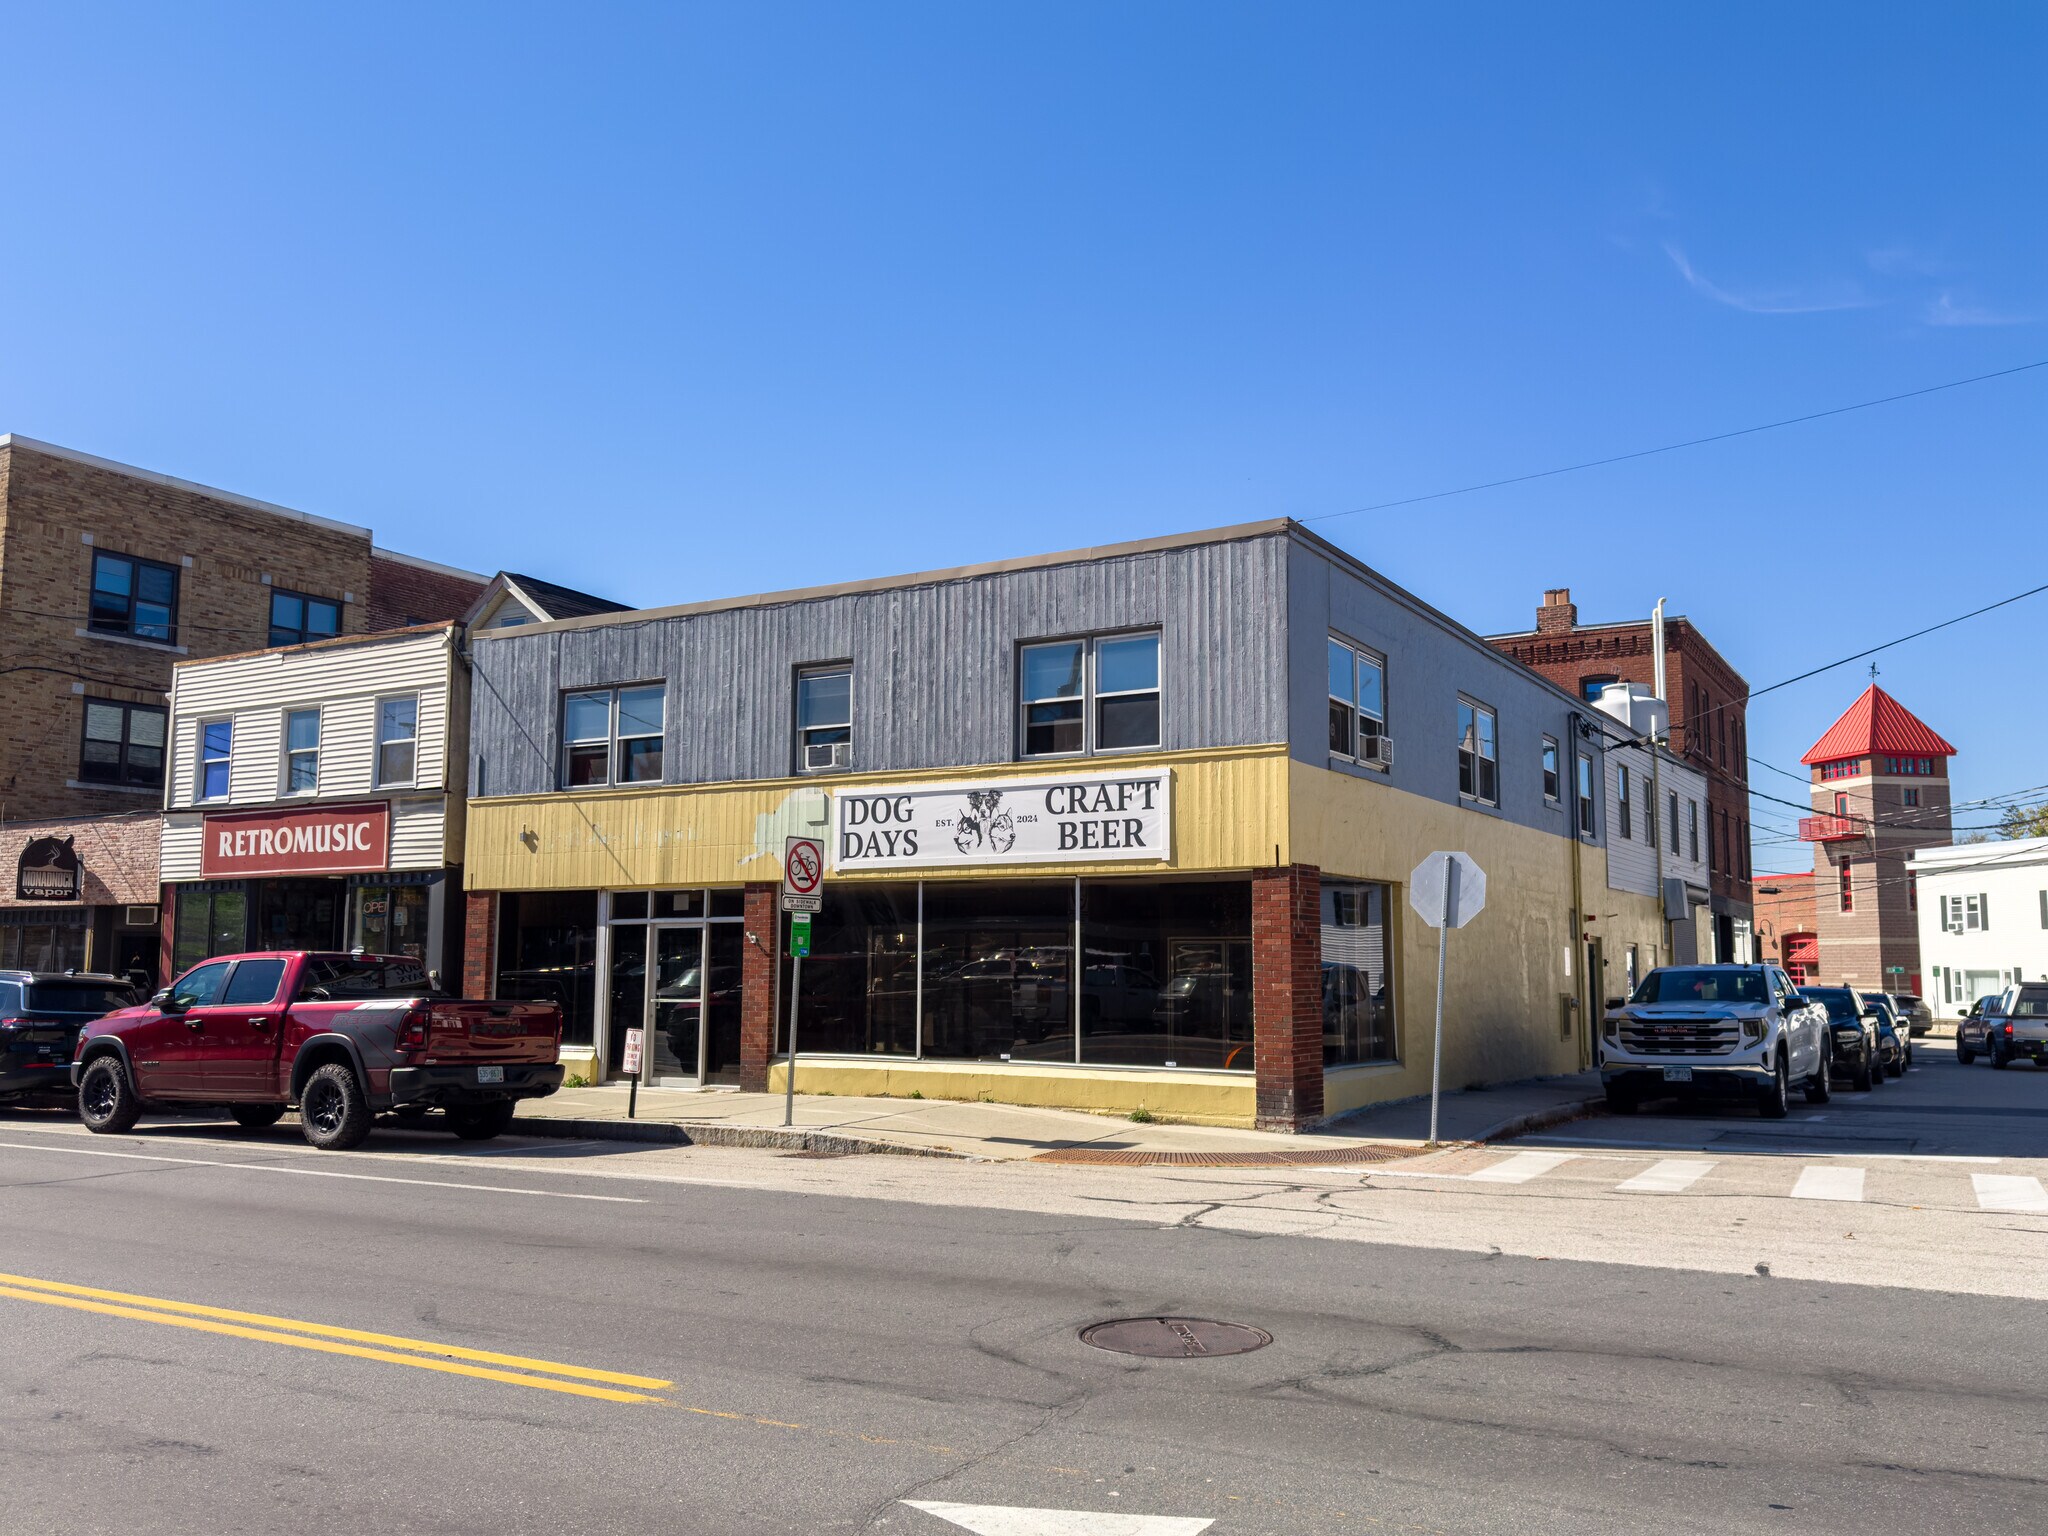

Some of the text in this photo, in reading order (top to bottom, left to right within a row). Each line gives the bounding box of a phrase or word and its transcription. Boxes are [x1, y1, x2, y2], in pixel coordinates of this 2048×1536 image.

[848, 795, 914, 826] DOG
[1045, 780, 1160, 815] CRAFT
[935, 814, 1038, 828] EST. 2024
[1057, 818, 1147, 851] BEER
[218, 822, 371, 857] RETROMUSIC
[843, 828, 919, 859] DAYS
[22, 871, 74, 888] MONADNOCK
[23, 888, 73, 897] vapor
